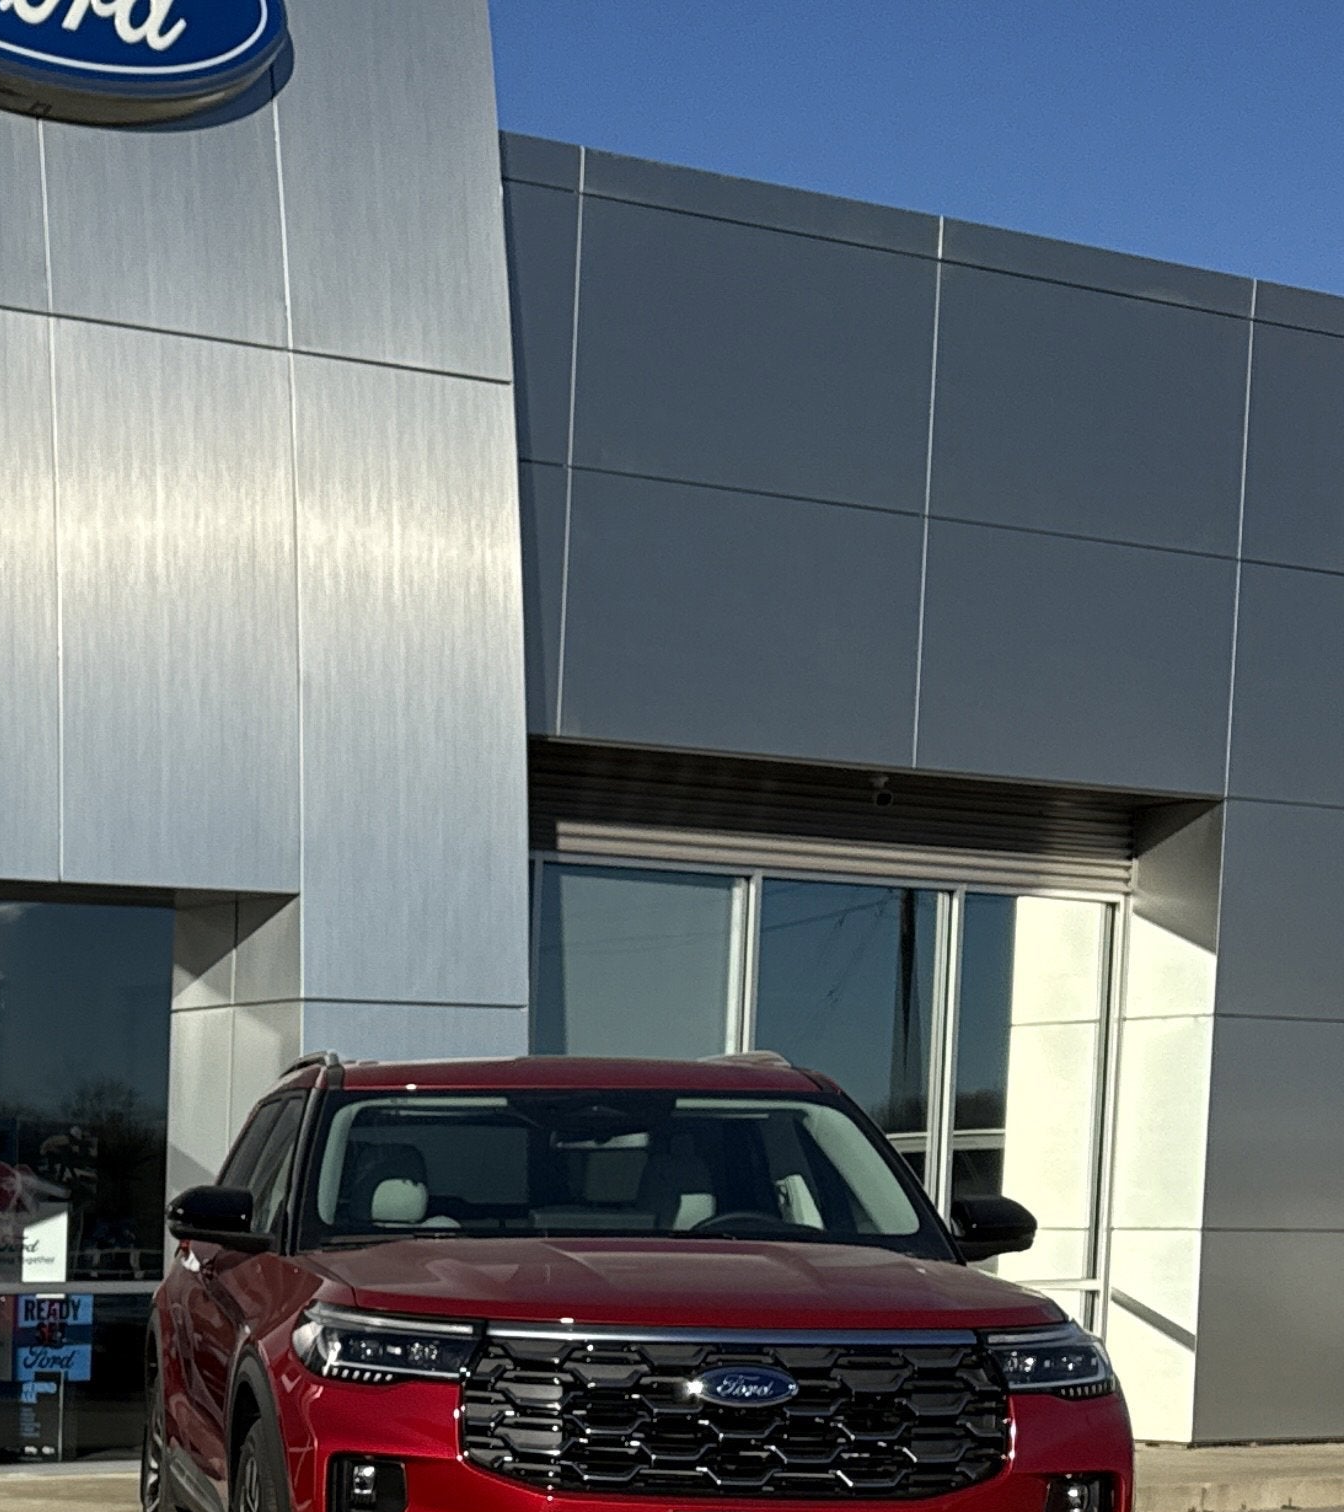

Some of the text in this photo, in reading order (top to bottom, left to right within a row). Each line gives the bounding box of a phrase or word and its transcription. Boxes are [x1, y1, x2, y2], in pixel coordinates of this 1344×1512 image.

[24, 1299, 81, 1322] READY
[23, 1346, 74, 1369] Ford
[716, 1374, 774, 1397] Ford
